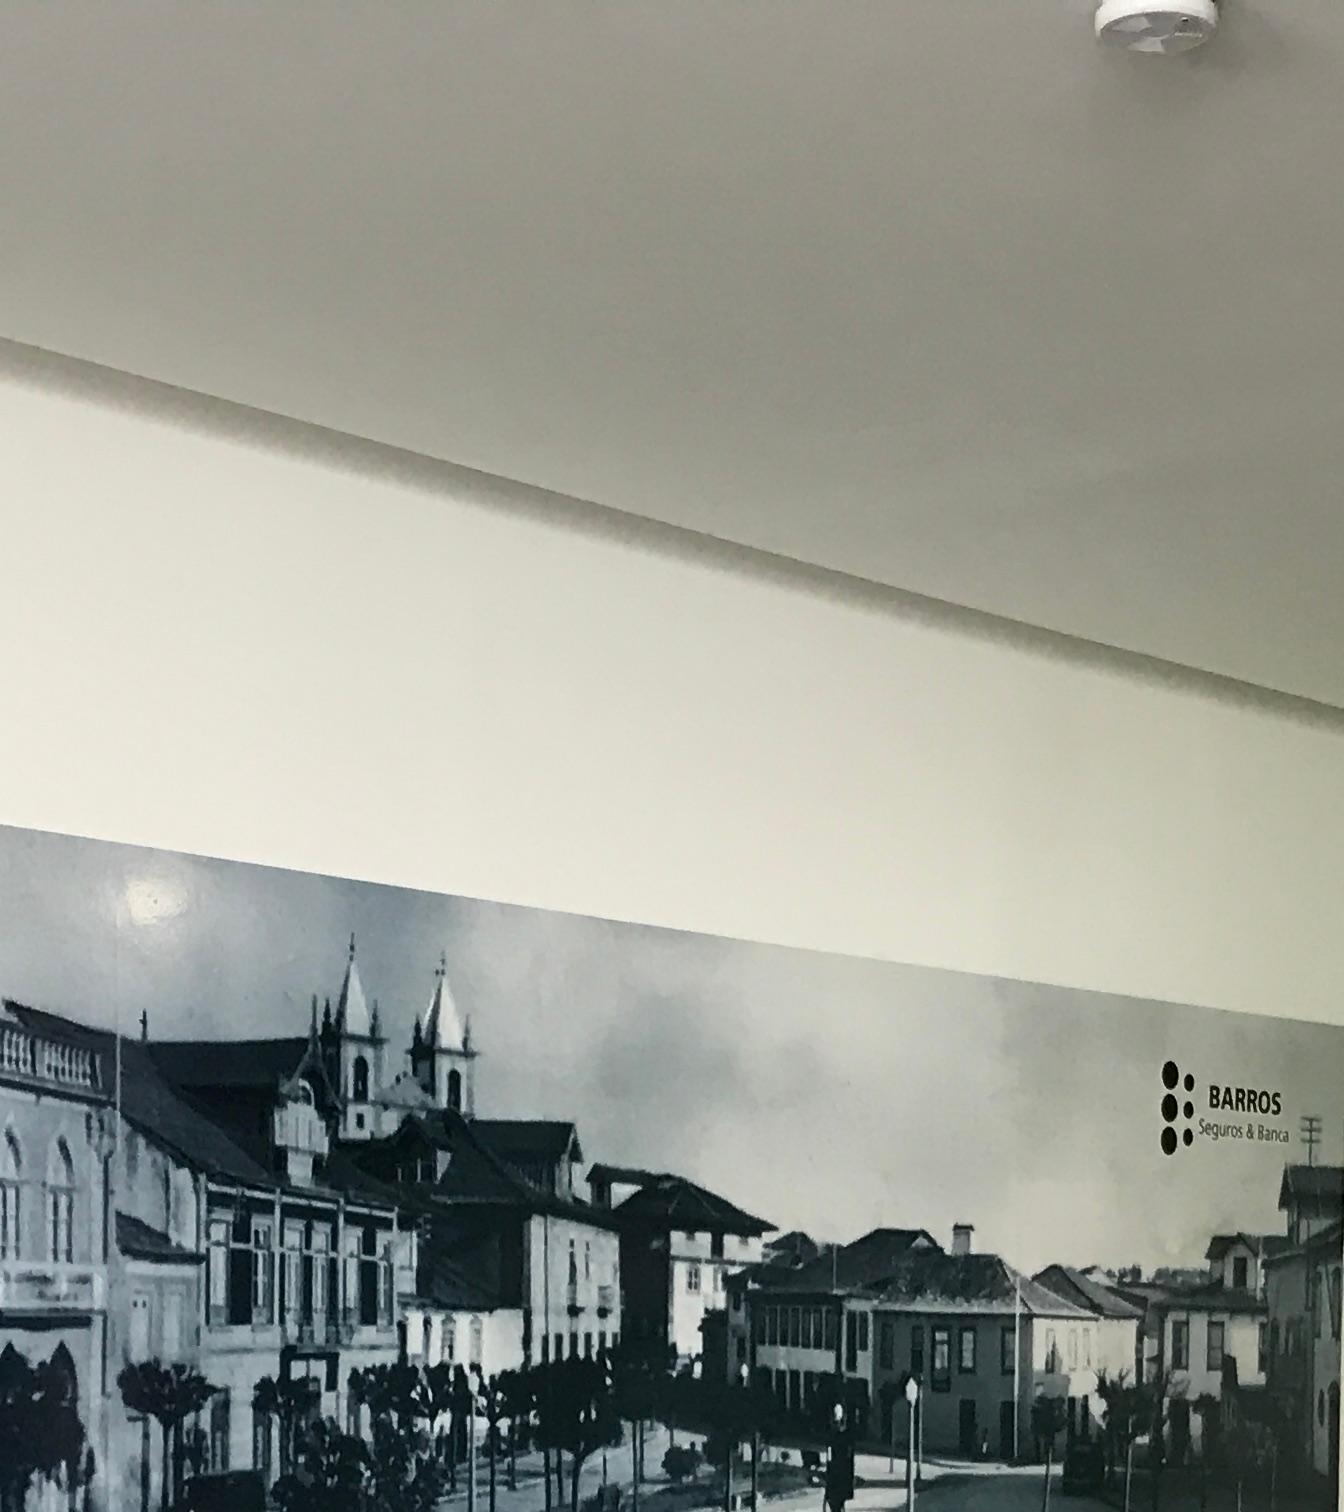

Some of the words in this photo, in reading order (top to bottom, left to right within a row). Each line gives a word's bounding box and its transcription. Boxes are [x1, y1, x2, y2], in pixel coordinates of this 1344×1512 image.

[1208, 1085, 1282, 1116] BARROS
[1198, 1118, 1243, 1141] Seguros
[1246, 1124, 1255, 1140] &
[1257, 1125, 1290, 1143] Banca
